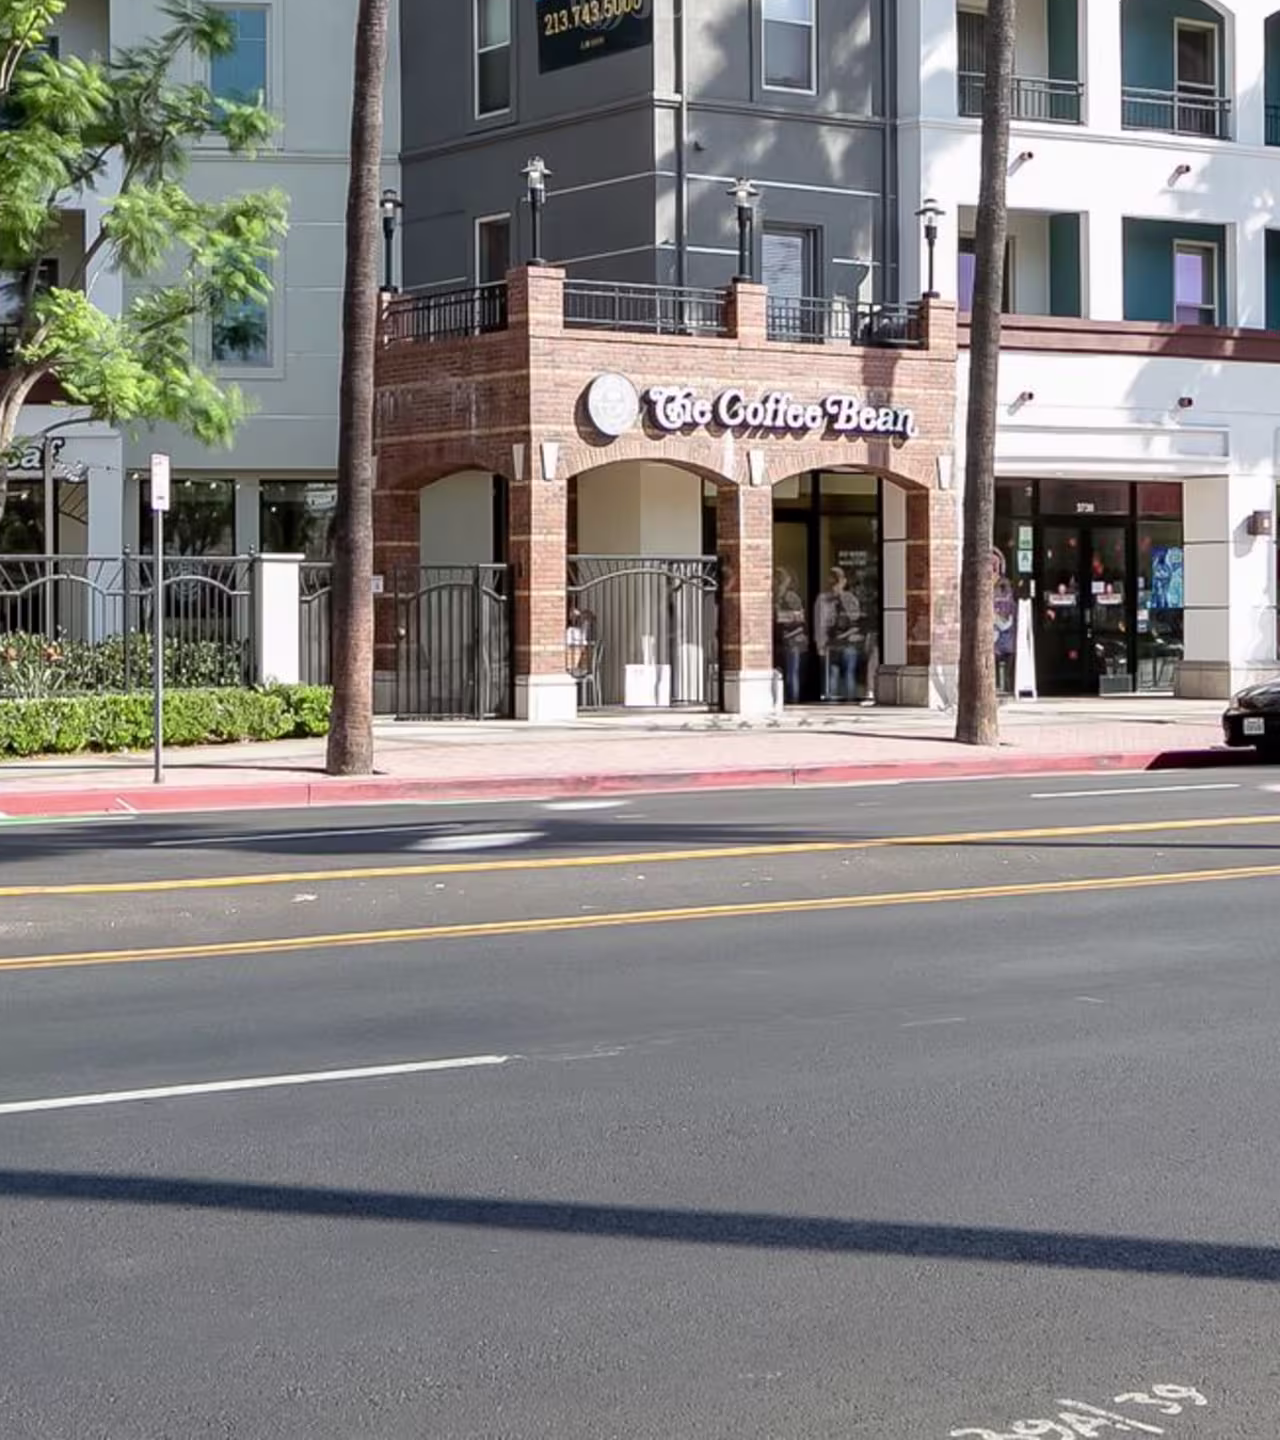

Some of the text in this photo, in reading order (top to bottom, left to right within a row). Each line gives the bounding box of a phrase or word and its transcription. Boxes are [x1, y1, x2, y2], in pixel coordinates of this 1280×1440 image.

[649, 386, 920, 437] The Coffee Bean
